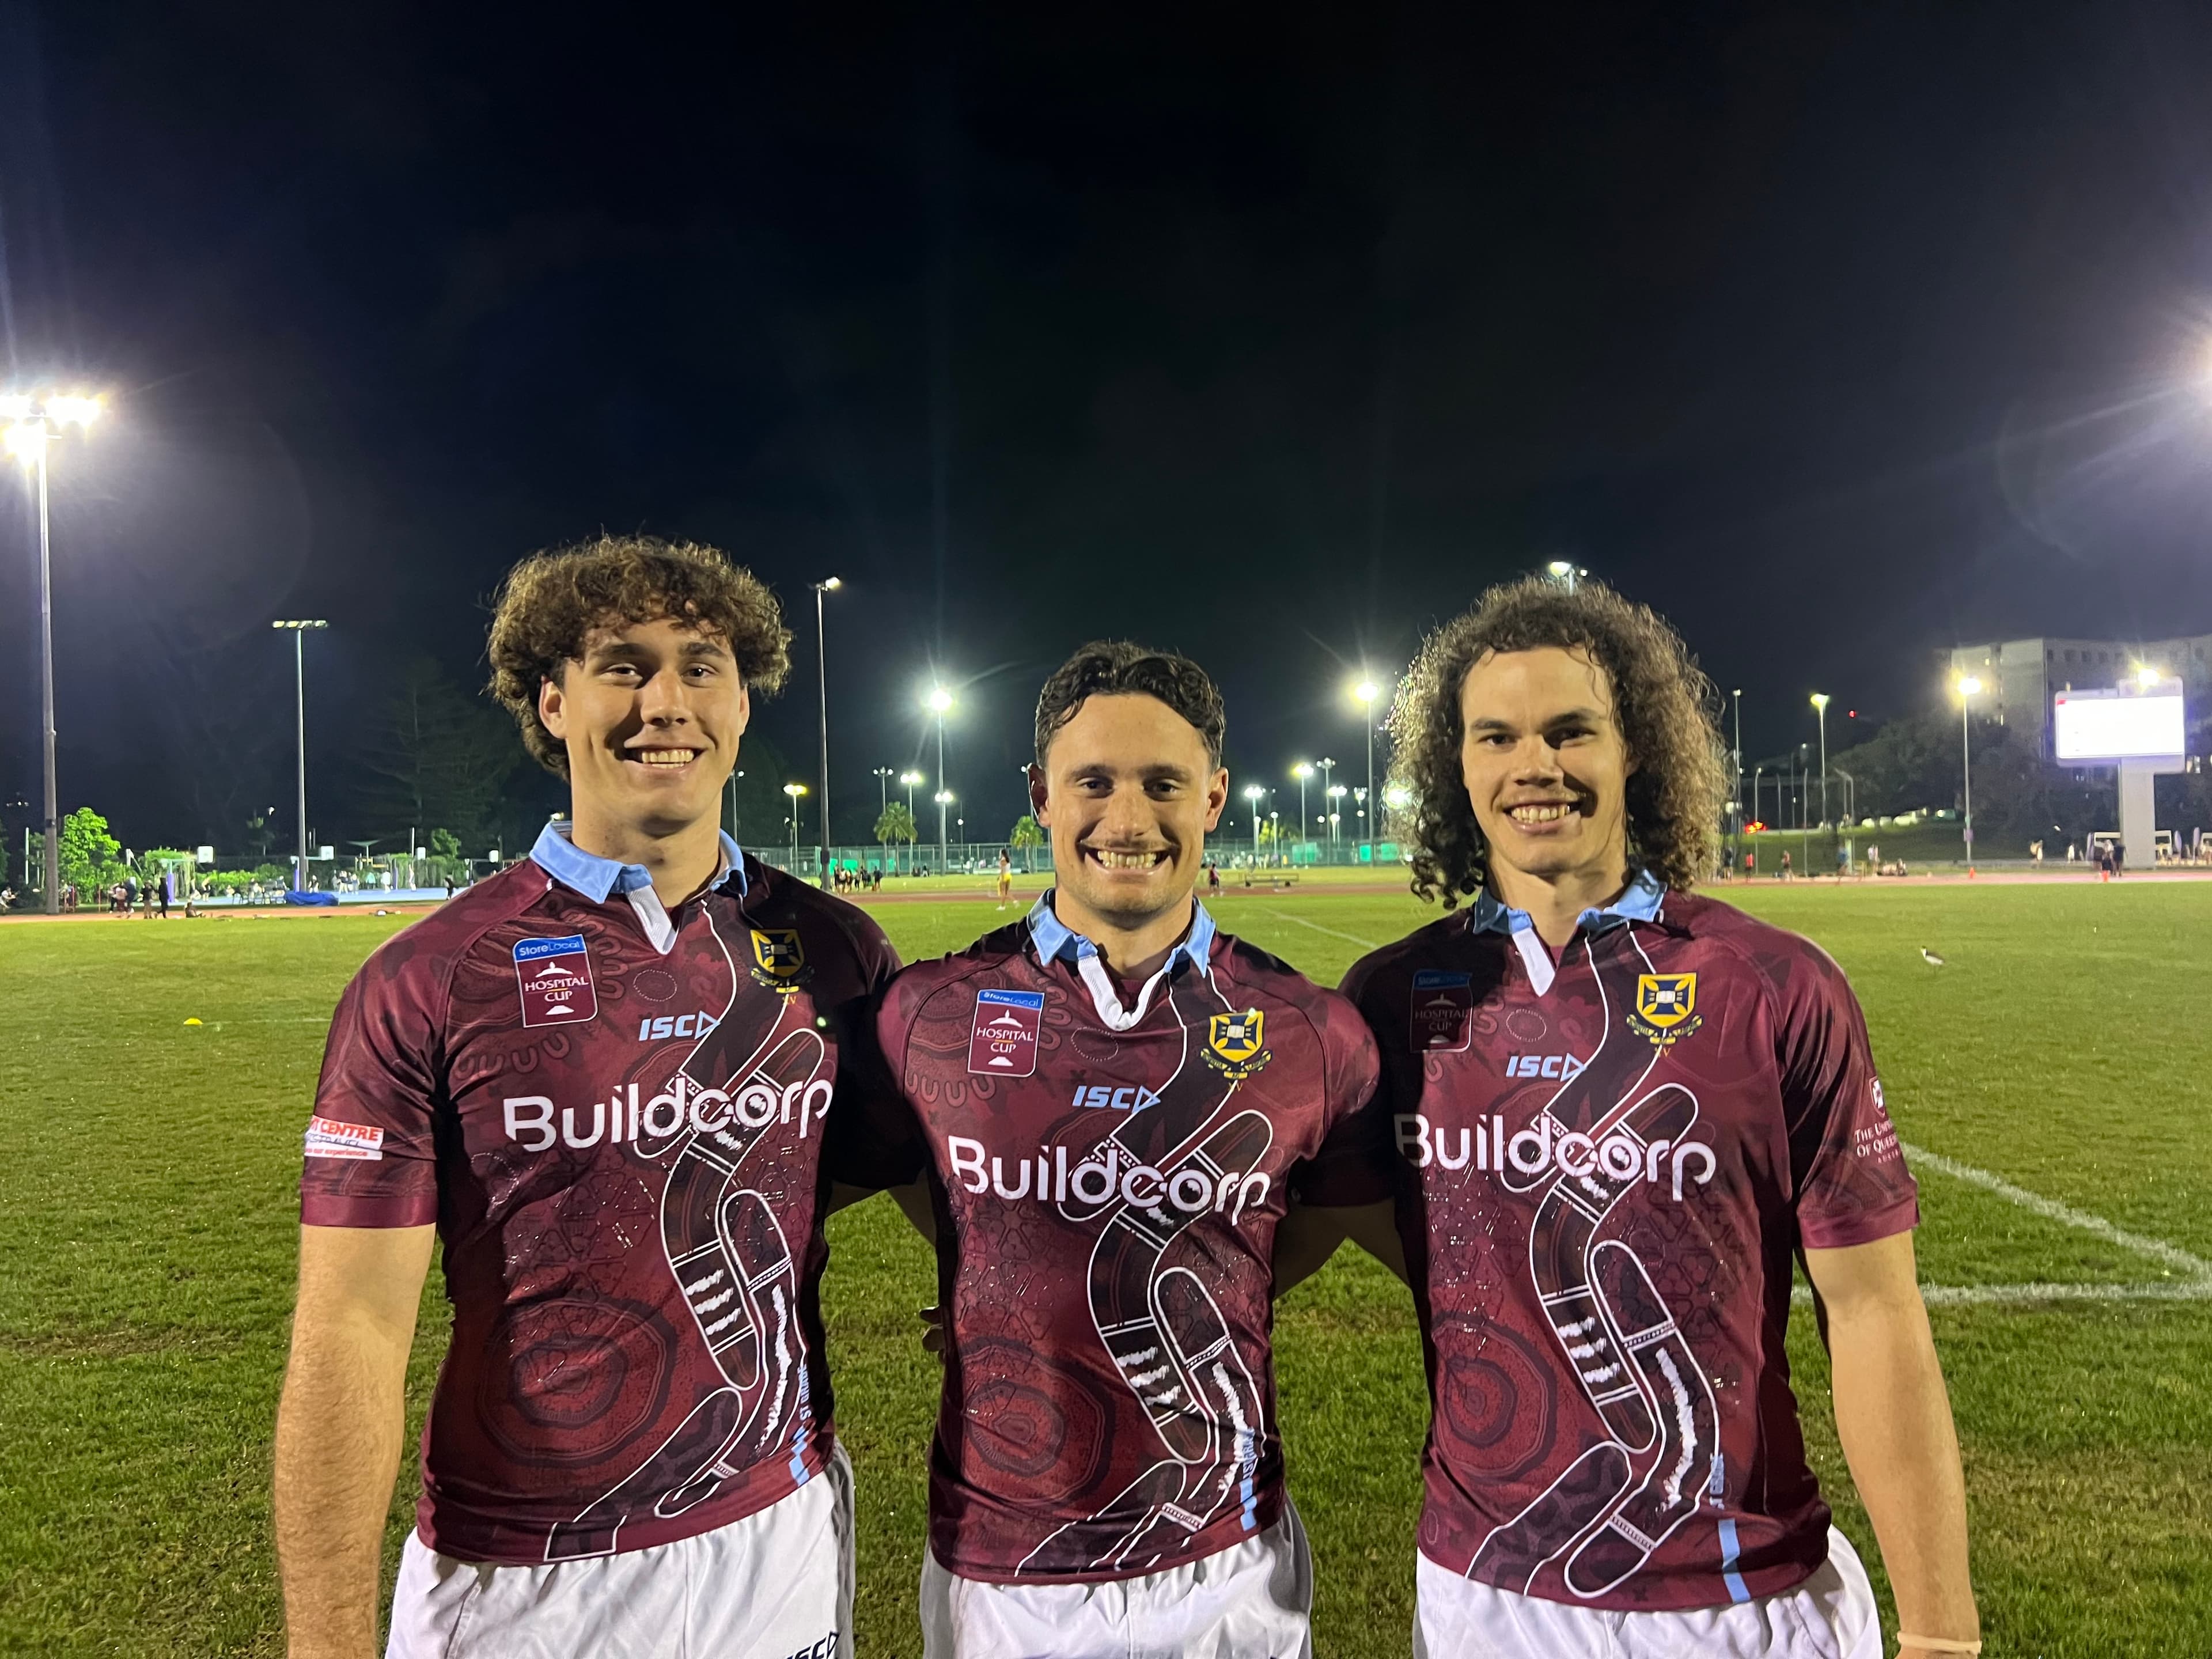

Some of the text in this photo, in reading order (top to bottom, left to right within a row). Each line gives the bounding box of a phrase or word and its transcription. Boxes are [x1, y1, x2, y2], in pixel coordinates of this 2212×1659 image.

[519, 941, 580, 956] StoreLocal
[525, 976, 589, 991] HOSPITAL
[544, 991, 573, 1002] CUP
[1415, 1009, 1468, 1019] HOSPITAL
[639, 1014, 696, 1041] ISC
[976, 1027, 1033, 1041] HOSPITAL
[1429, 1021, 1452, 1031] CUP
[990, 1042, 1017, 1054] CUP
[1506, 1055, 1562, 1078] ISC
[1072, 1085, 1134, 1110] ISC
[503, 1076, 834, 1153] Buildcorp
[320, 1119, 384, 1142] CENTRE
[1394, 1112, 1717, 1202] Buildcorp
[948, 1135, 1271, 1227] Buildcorp
